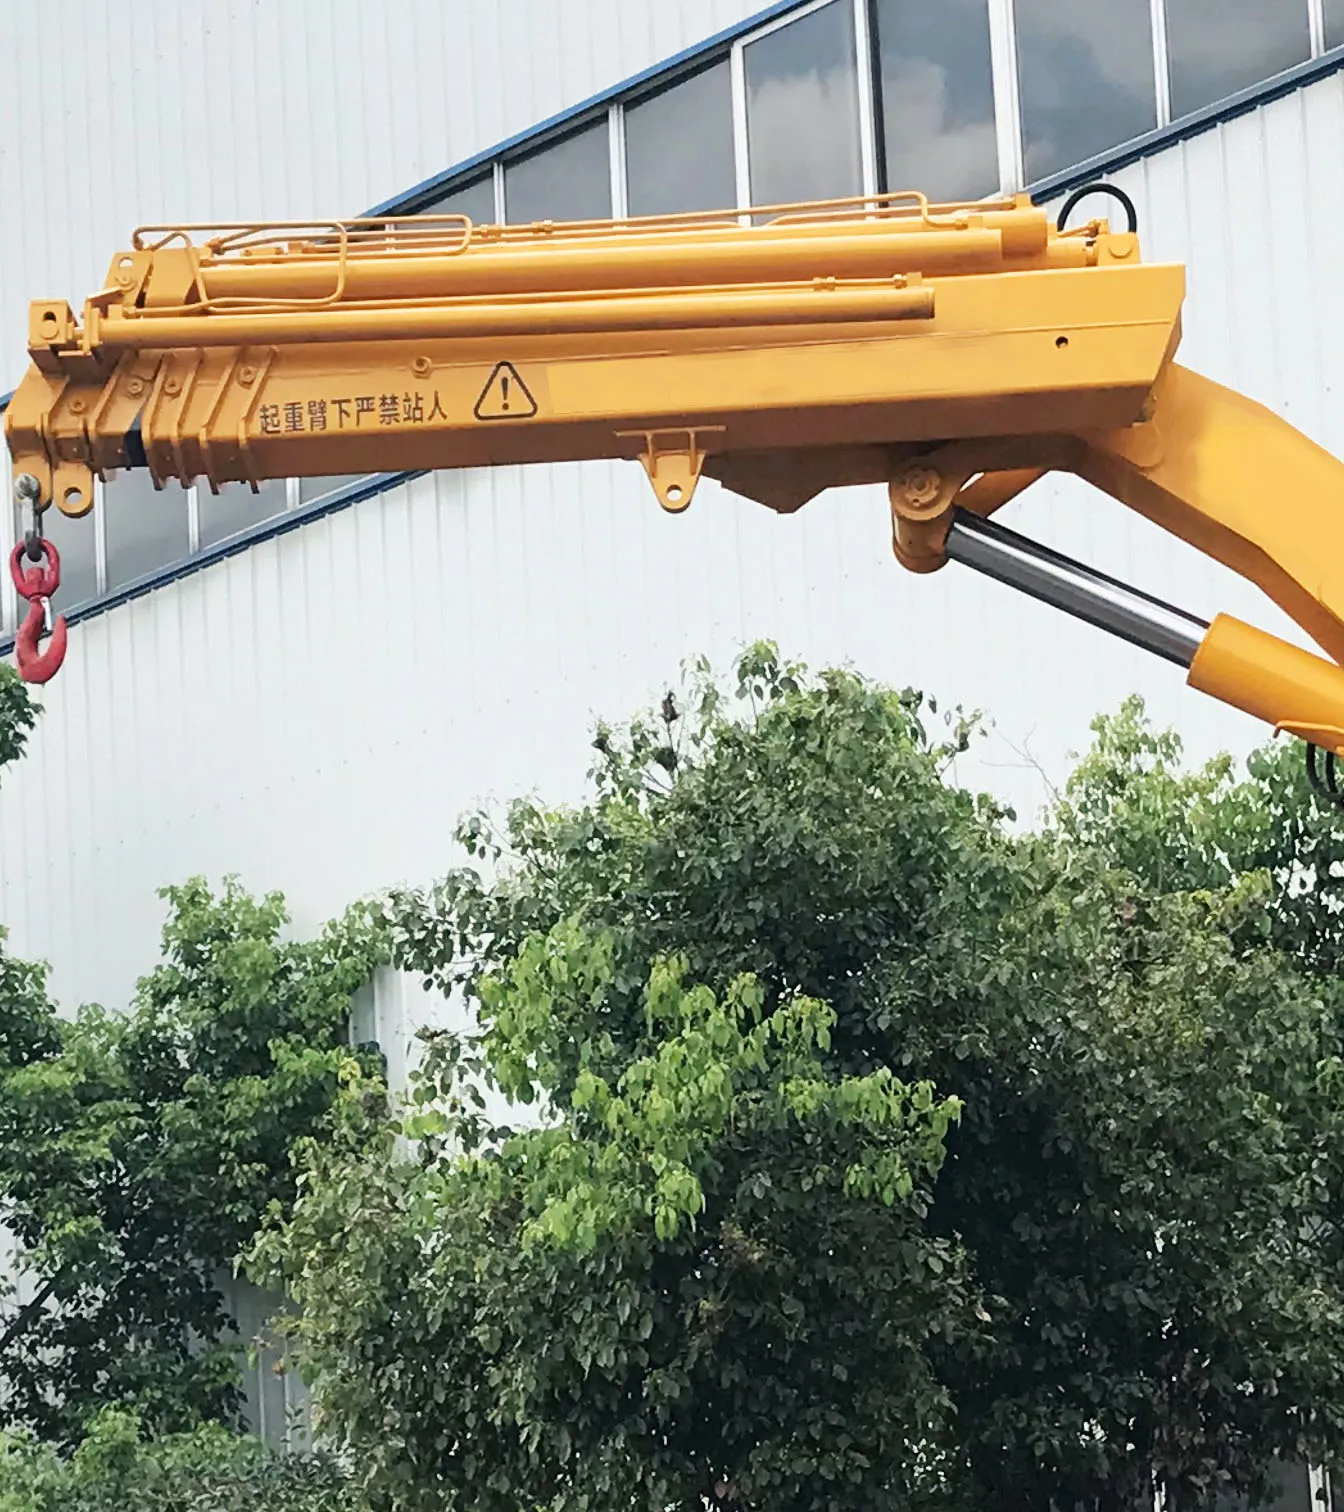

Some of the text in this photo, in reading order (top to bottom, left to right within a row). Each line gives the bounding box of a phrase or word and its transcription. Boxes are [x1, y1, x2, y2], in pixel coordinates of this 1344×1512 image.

[258, 390, 448, 435] 起重臂下严禁站人
